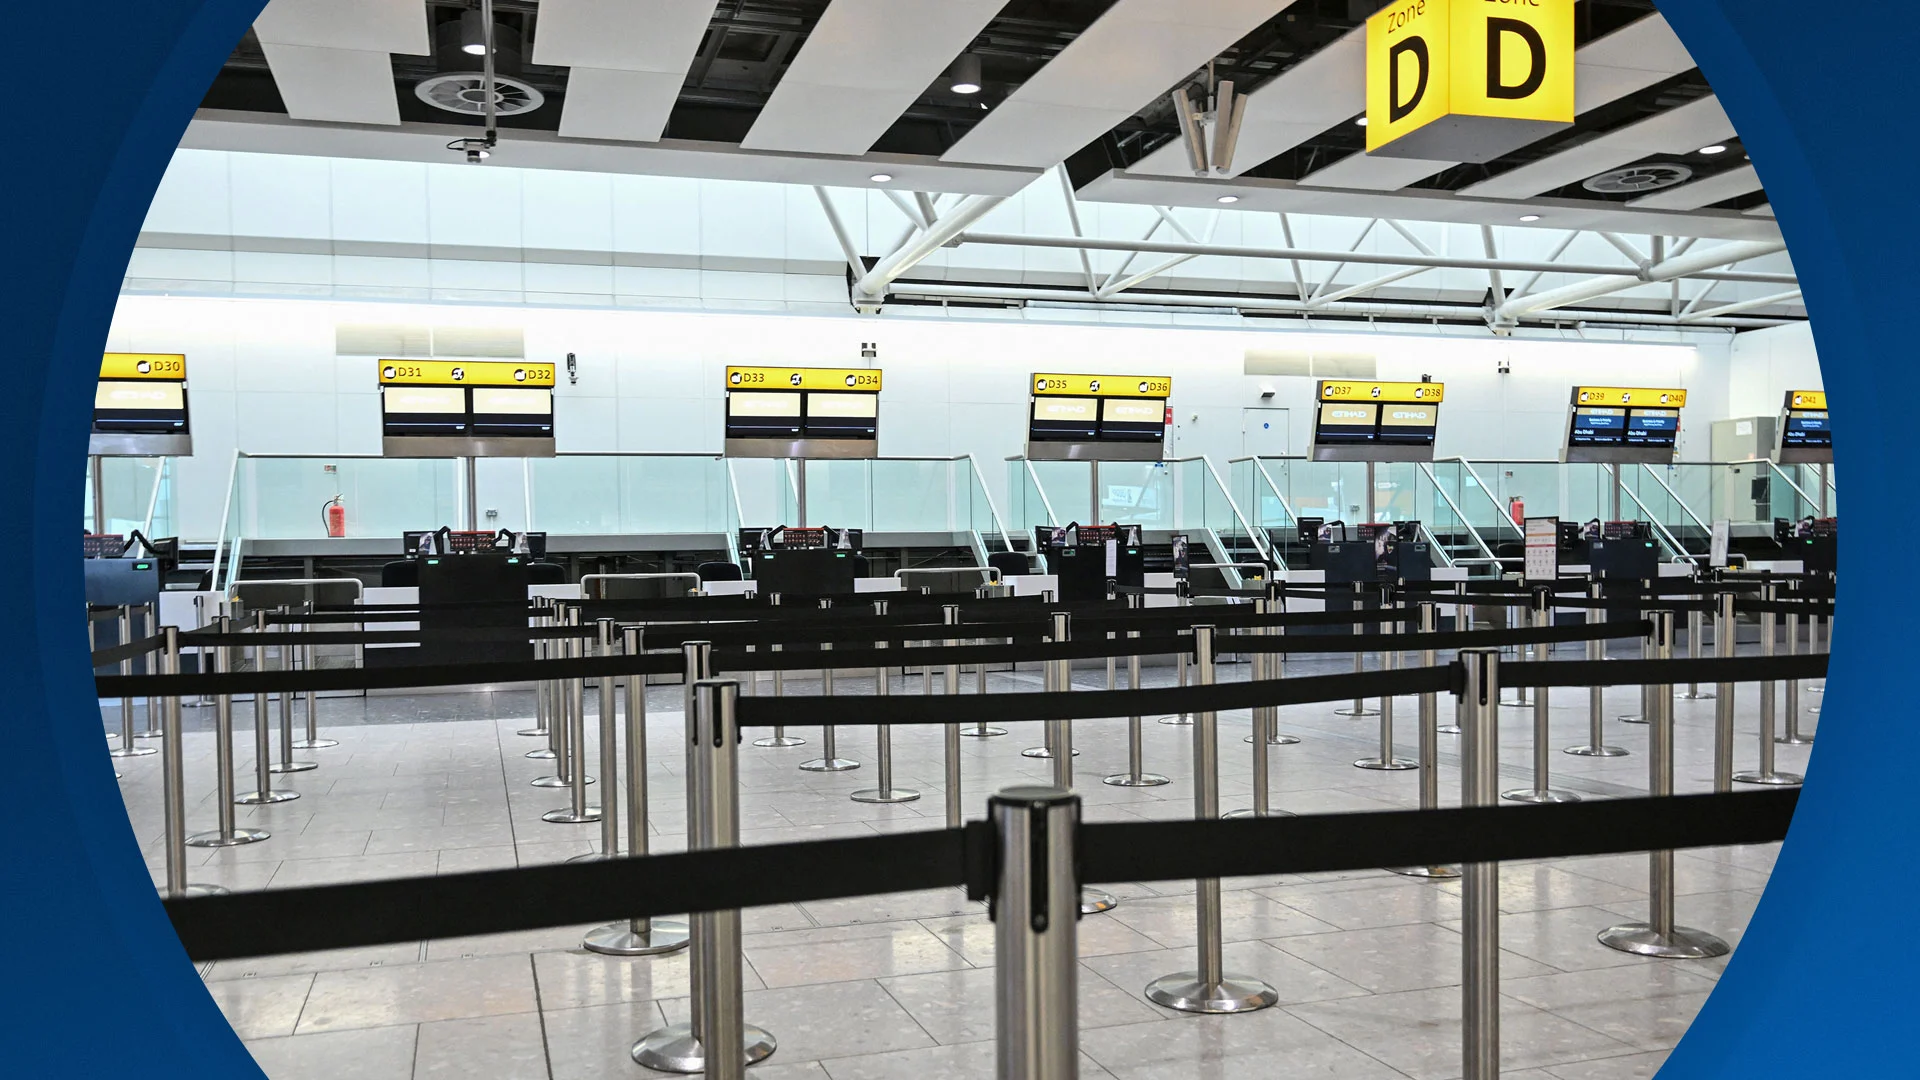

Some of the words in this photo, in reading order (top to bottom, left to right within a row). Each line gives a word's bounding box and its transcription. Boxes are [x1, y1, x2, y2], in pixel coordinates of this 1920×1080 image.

[1387, 0, 1426, 34] Zone
[1486, 16, 1546, 100] D
[1389, 35, 1429, 124] D
[154, 361, 180, 372] D30
[398, 367, 422, 377] D31
[528, 370, 551, 380] D32
[743, 373, 765, 383] D33
[858, 375, 878, 385] D34
[1048, 379, 1067, 389] D35
[1149, 382, 1168, 391] D36
[1334, 386, 1352, 395] D37
[1424, 388, 1441, 397] D38
[1589, 392, 1605, 401] D39
[1668, 394, 1684, 402] D40
[1331, 410, 1367, 418] ETIHAD
[1392, 411, 1428, 419] ETIHAD
